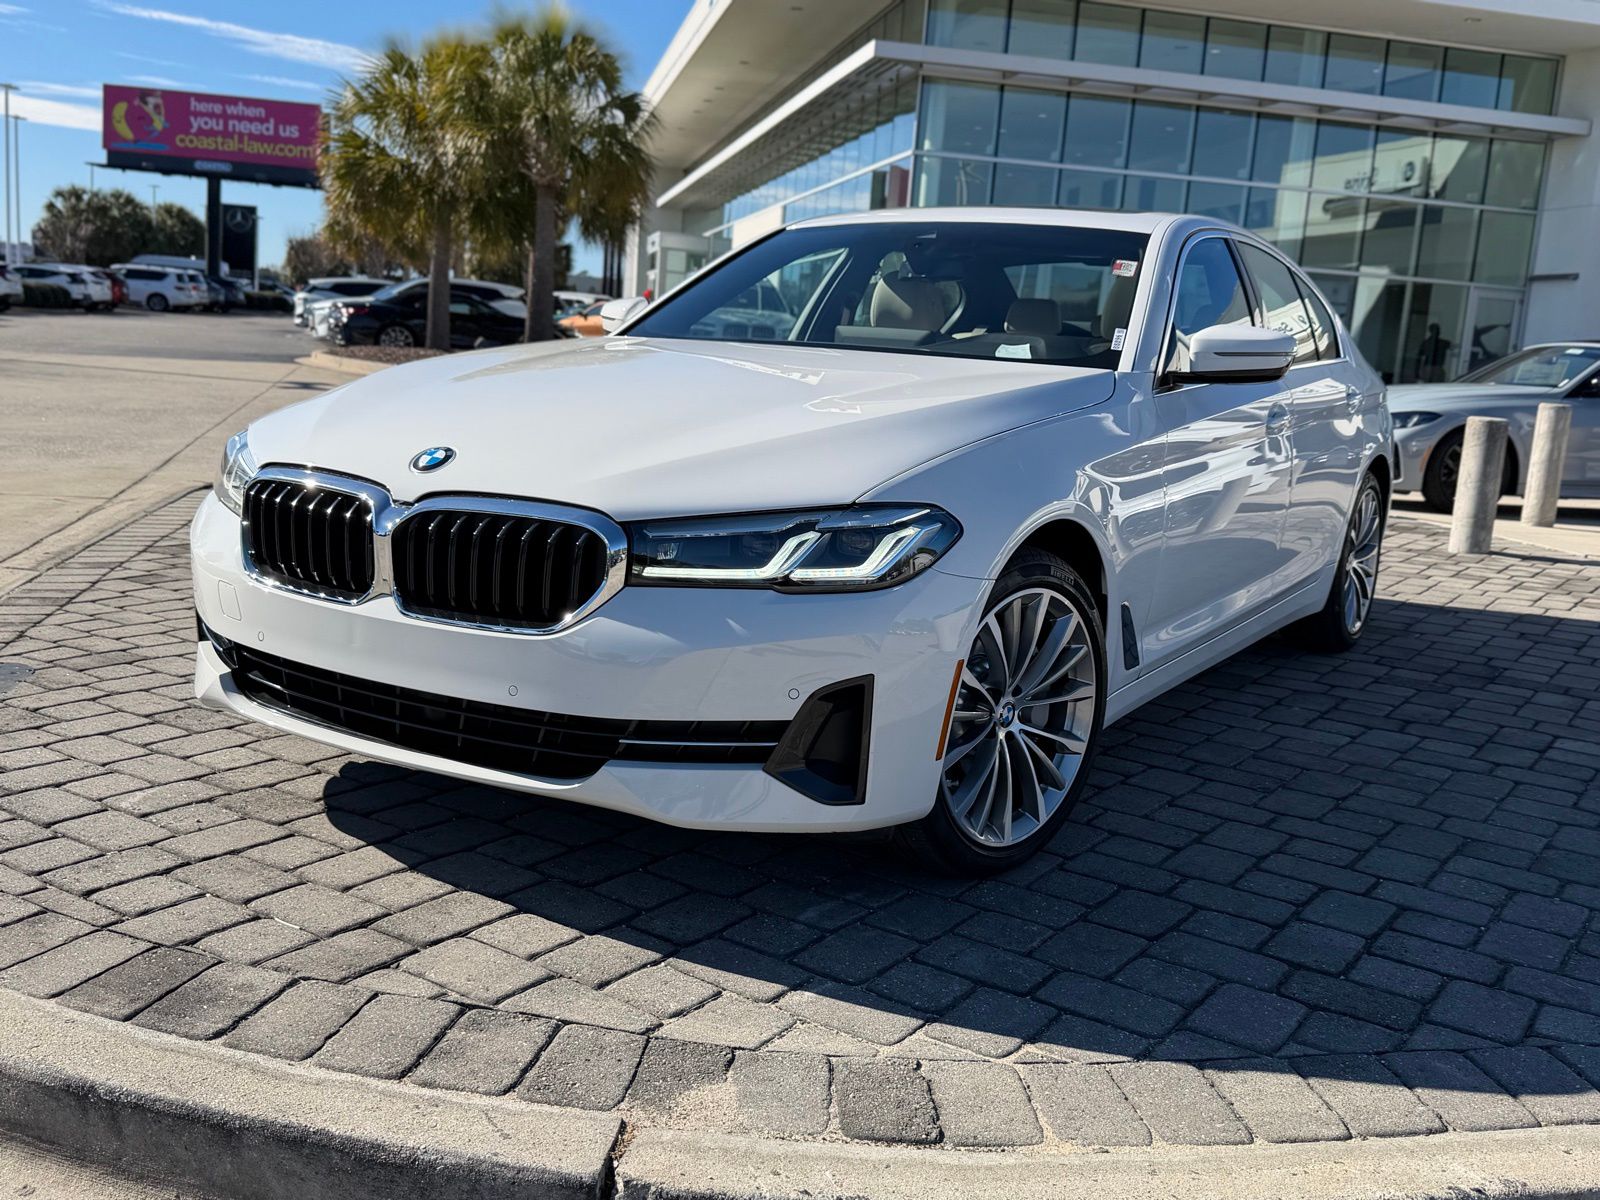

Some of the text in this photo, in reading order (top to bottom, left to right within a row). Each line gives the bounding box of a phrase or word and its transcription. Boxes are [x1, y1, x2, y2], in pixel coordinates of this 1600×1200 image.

[190, 97, 265, 118] here when
[190, 115, 299, 138] you need us
[175, 134, 313, 158] coastal-law.com
